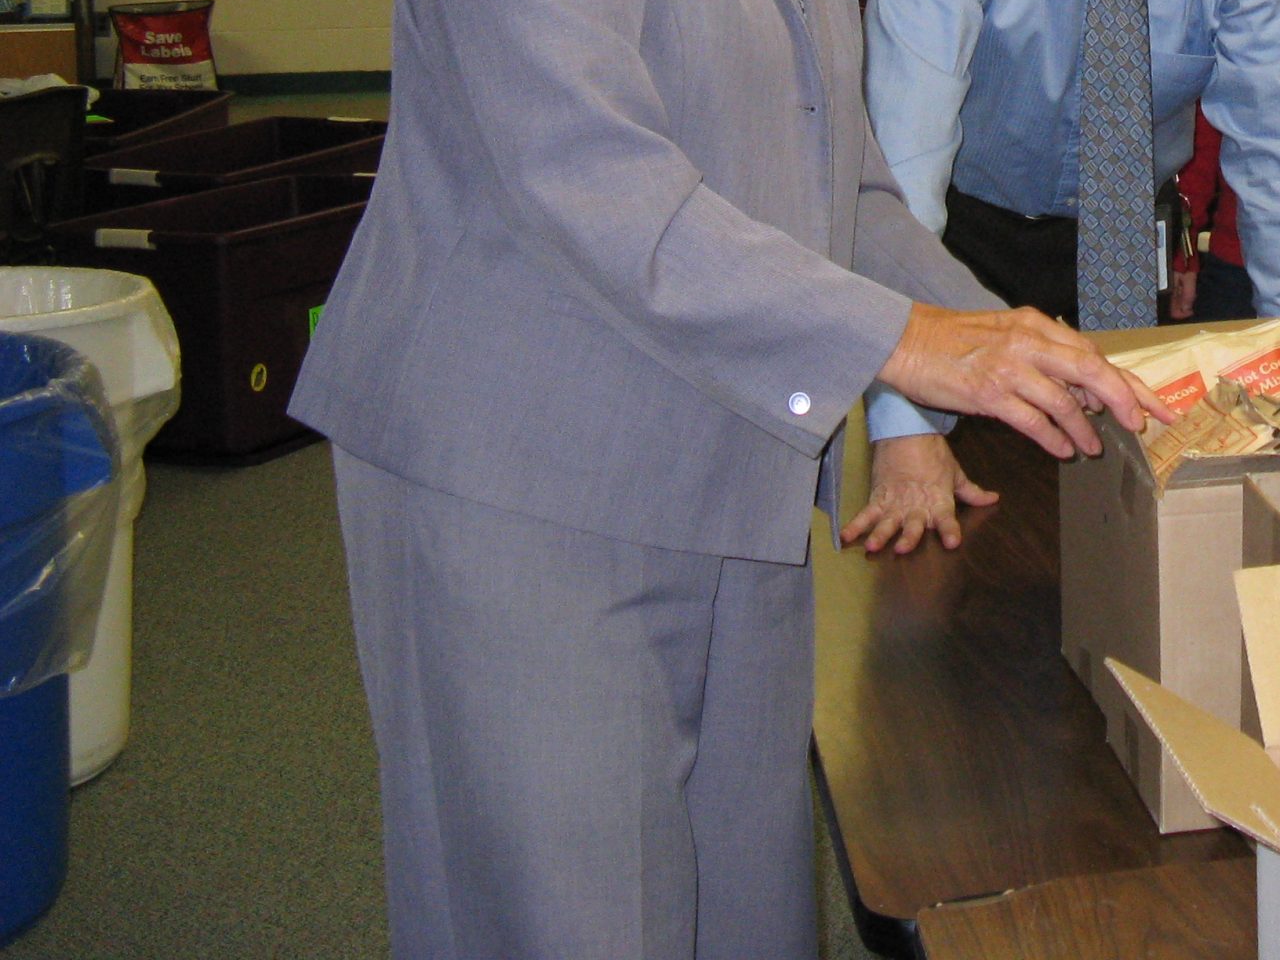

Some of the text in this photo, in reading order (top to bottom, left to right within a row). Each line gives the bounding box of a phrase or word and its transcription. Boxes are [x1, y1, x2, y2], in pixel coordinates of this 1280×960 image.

[143, 31, 183, 45] Save
[141, 44, 193, 58] Labels
[1236, 369, 1259, 388] Hot
